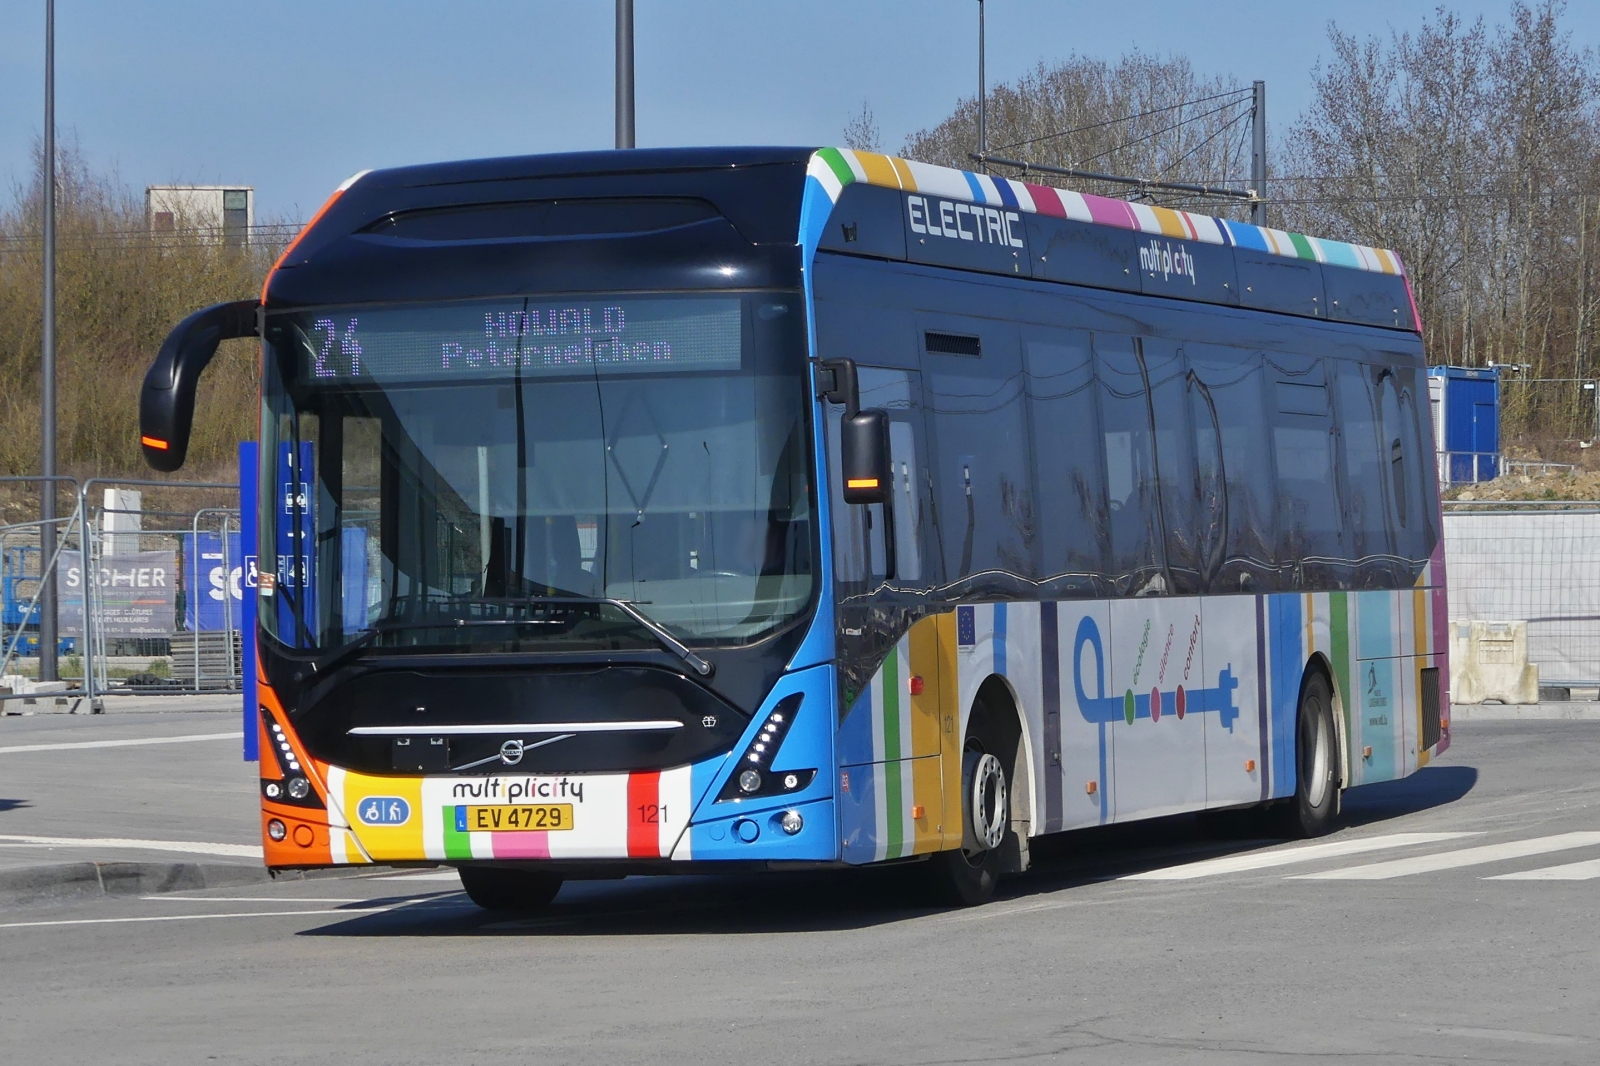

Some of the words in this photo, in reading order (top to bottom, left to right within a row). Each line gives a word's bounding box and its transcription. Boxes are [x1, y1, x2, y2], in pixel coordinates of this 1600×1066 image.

[908, 195, 1024, 249] ELECTRIC
[1140, 239, 1196, 286] multiplicity
[484, 306, 625, 338] HOWALD
[313, 316, 363, 378] 24
[441, 336, 672, 368] Peternelchen
[1133, 619, 1151, 685] écologie
[1159, 624, 1174, 684] silence
[1184, 614, 1200, 681] confort
[452, 777, 584, 803] multiplicity
[637, 804, 668, 823] 121
[477, 808, 502, 828] EV
[507, 808, 562, 828] 4729
